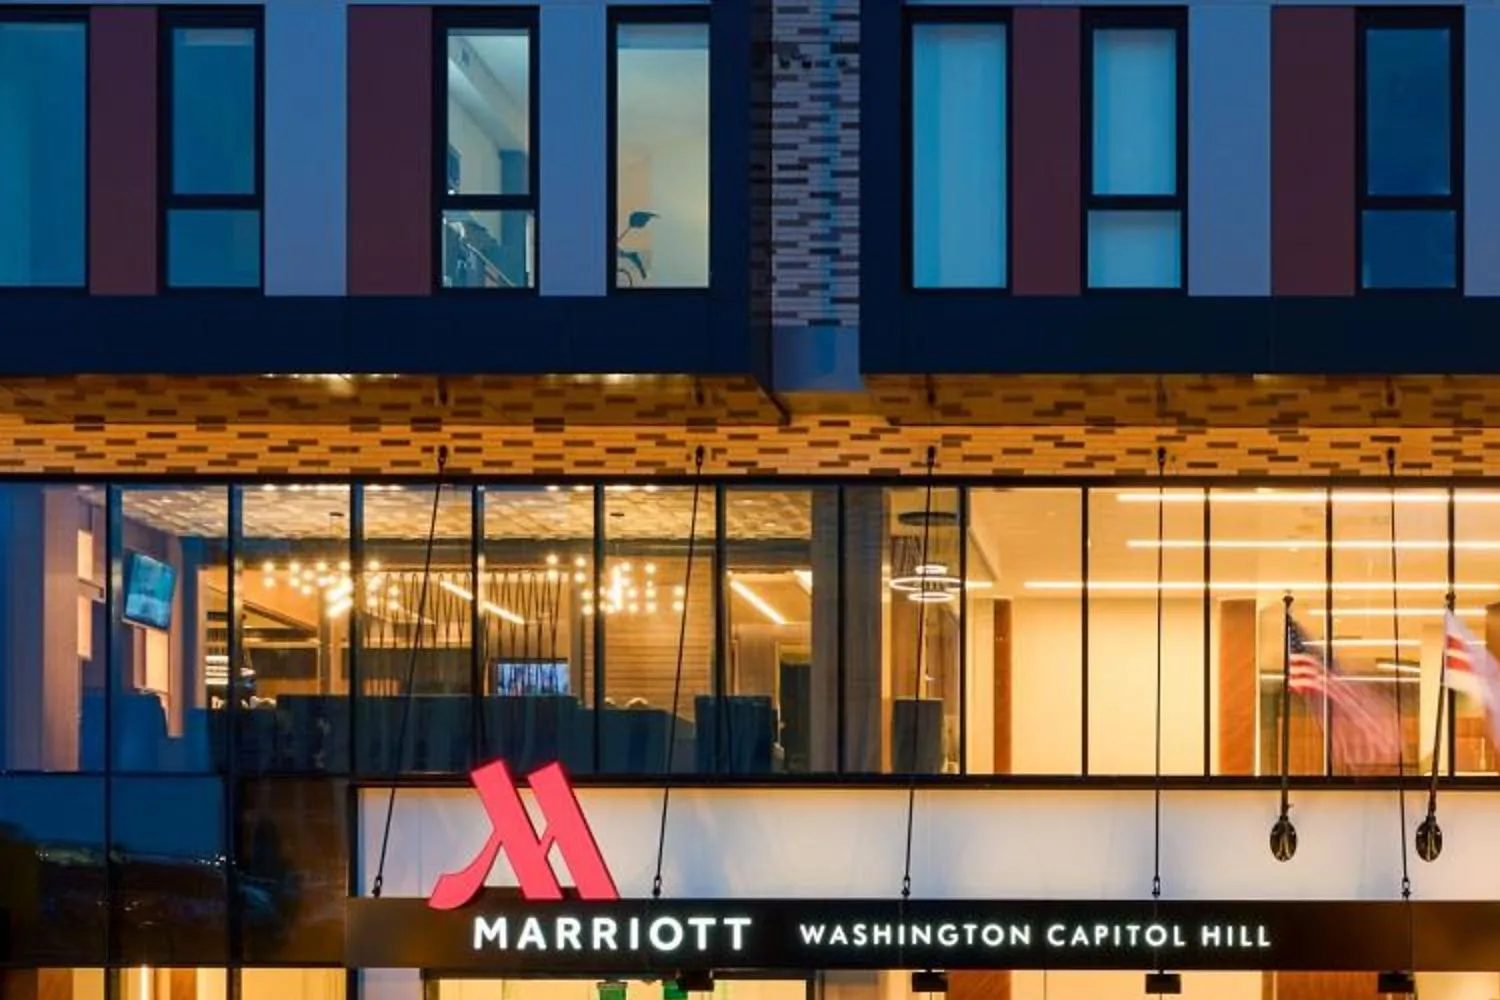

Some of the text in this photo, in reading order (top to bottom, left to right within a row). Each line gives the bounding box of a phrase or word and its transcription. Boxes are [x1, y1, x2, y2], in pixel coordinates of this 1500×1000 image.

[472, 915, 753, 951] MARRIOTT
[798, 922, 1272, 948] WASHINGTON CAPITOL HILL
